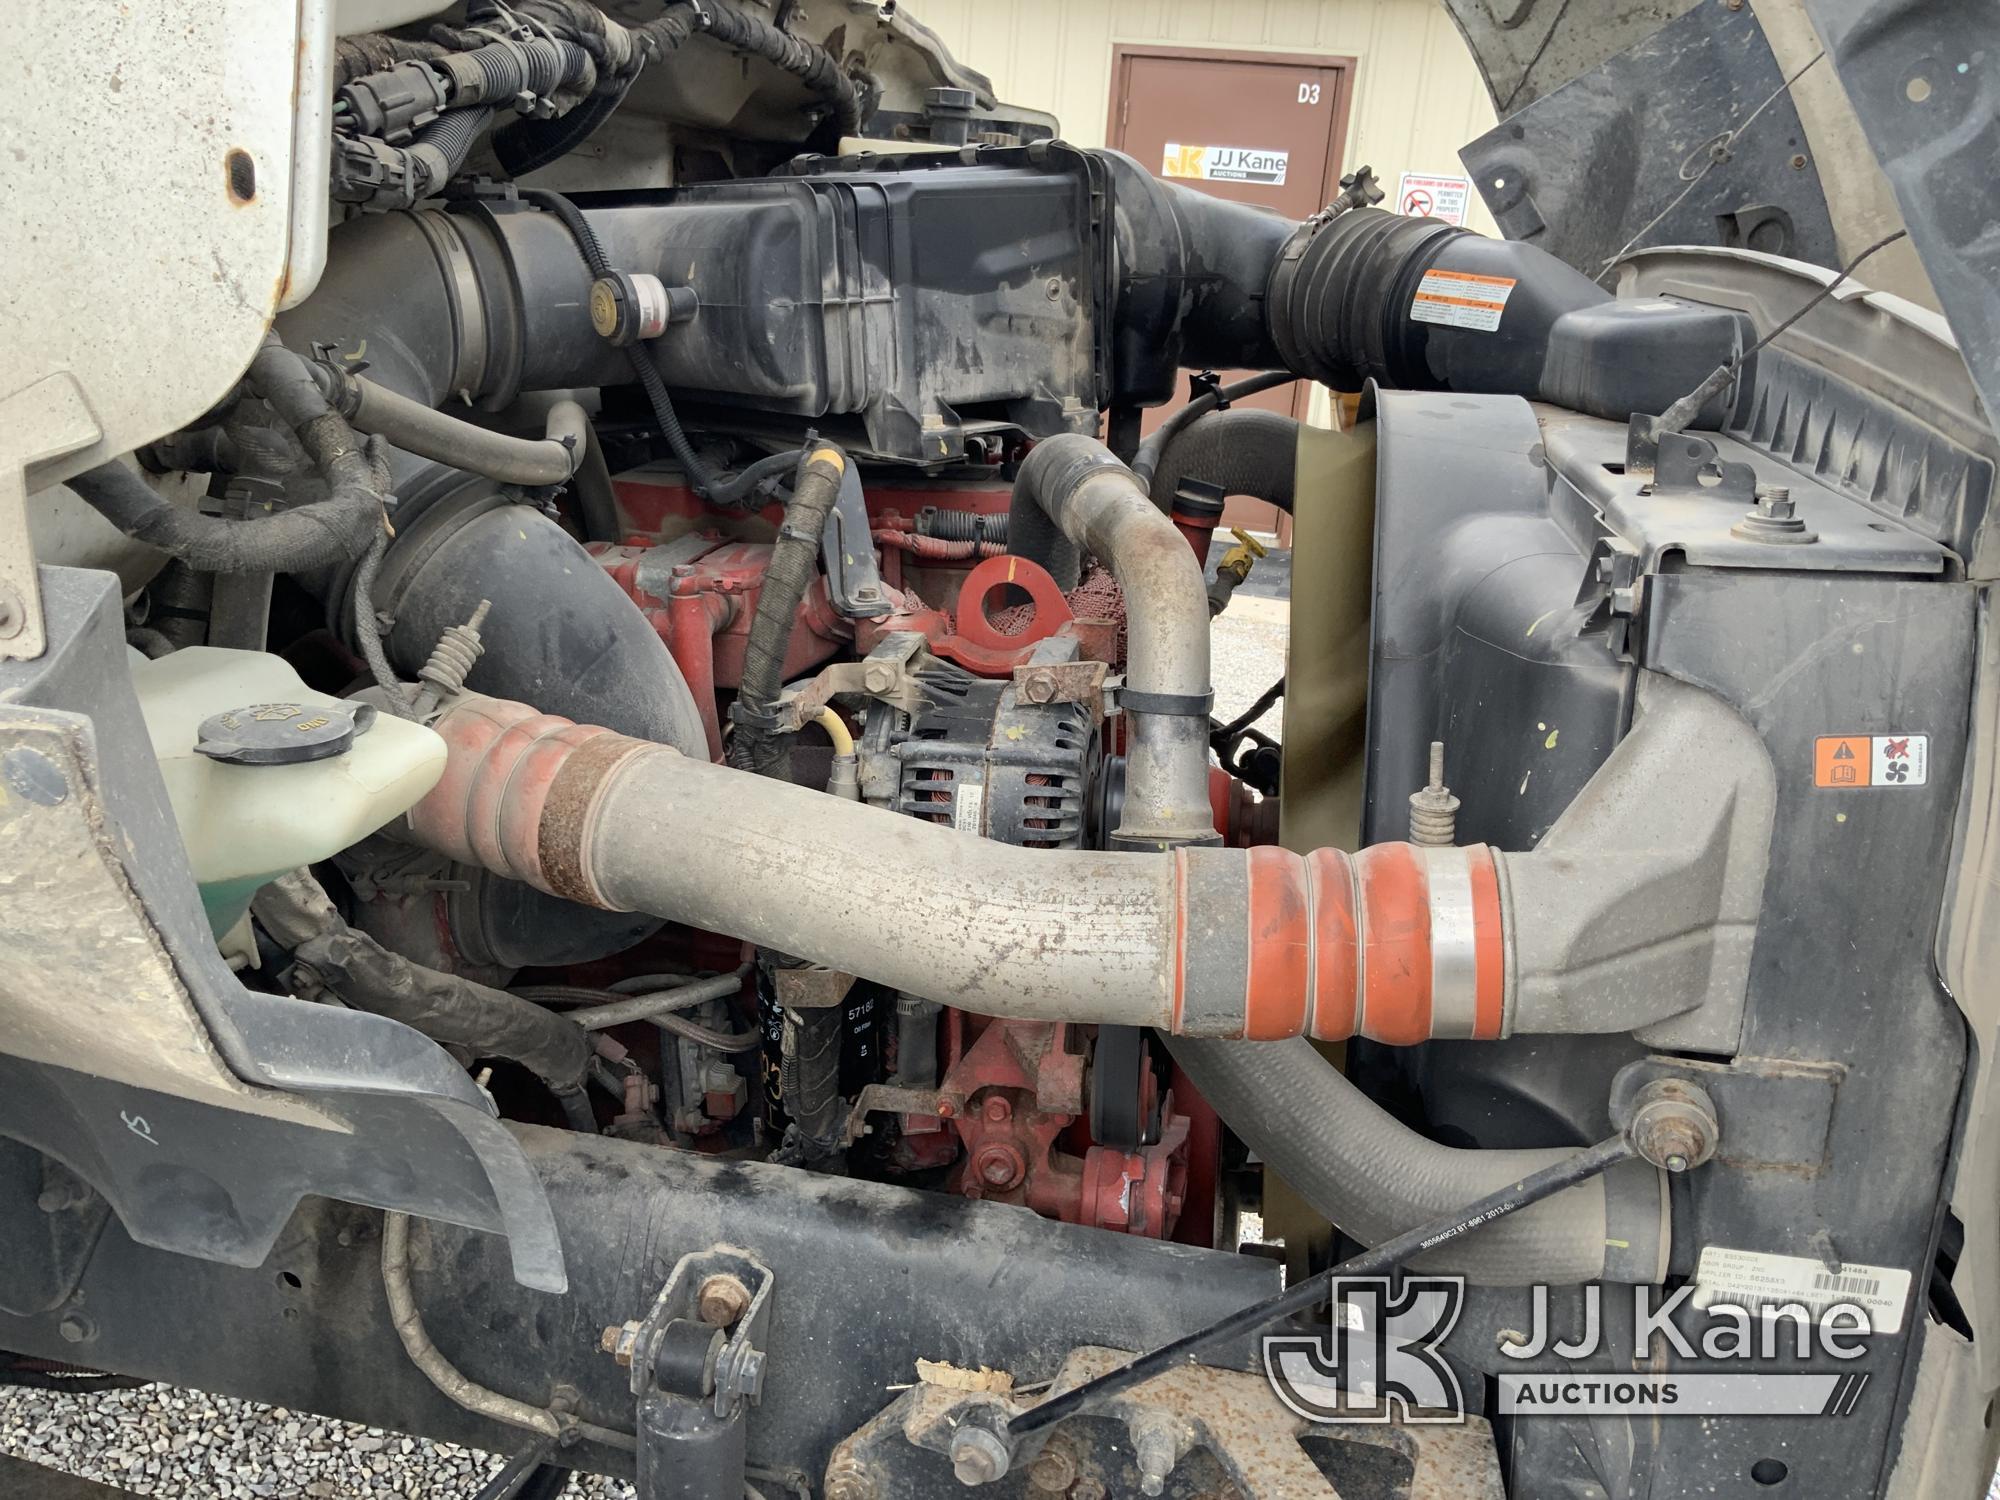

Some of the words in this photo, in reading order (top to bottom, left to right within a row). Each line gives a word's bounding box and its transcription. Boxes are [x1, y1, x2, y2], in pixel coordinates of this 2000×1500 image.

[1298, 83, 1320, 104] D3
[1211, 150, 1233, 167] JJ
[1238, 152, 1286, 171] Kane
[848, 999, 874, 1020] 57182
